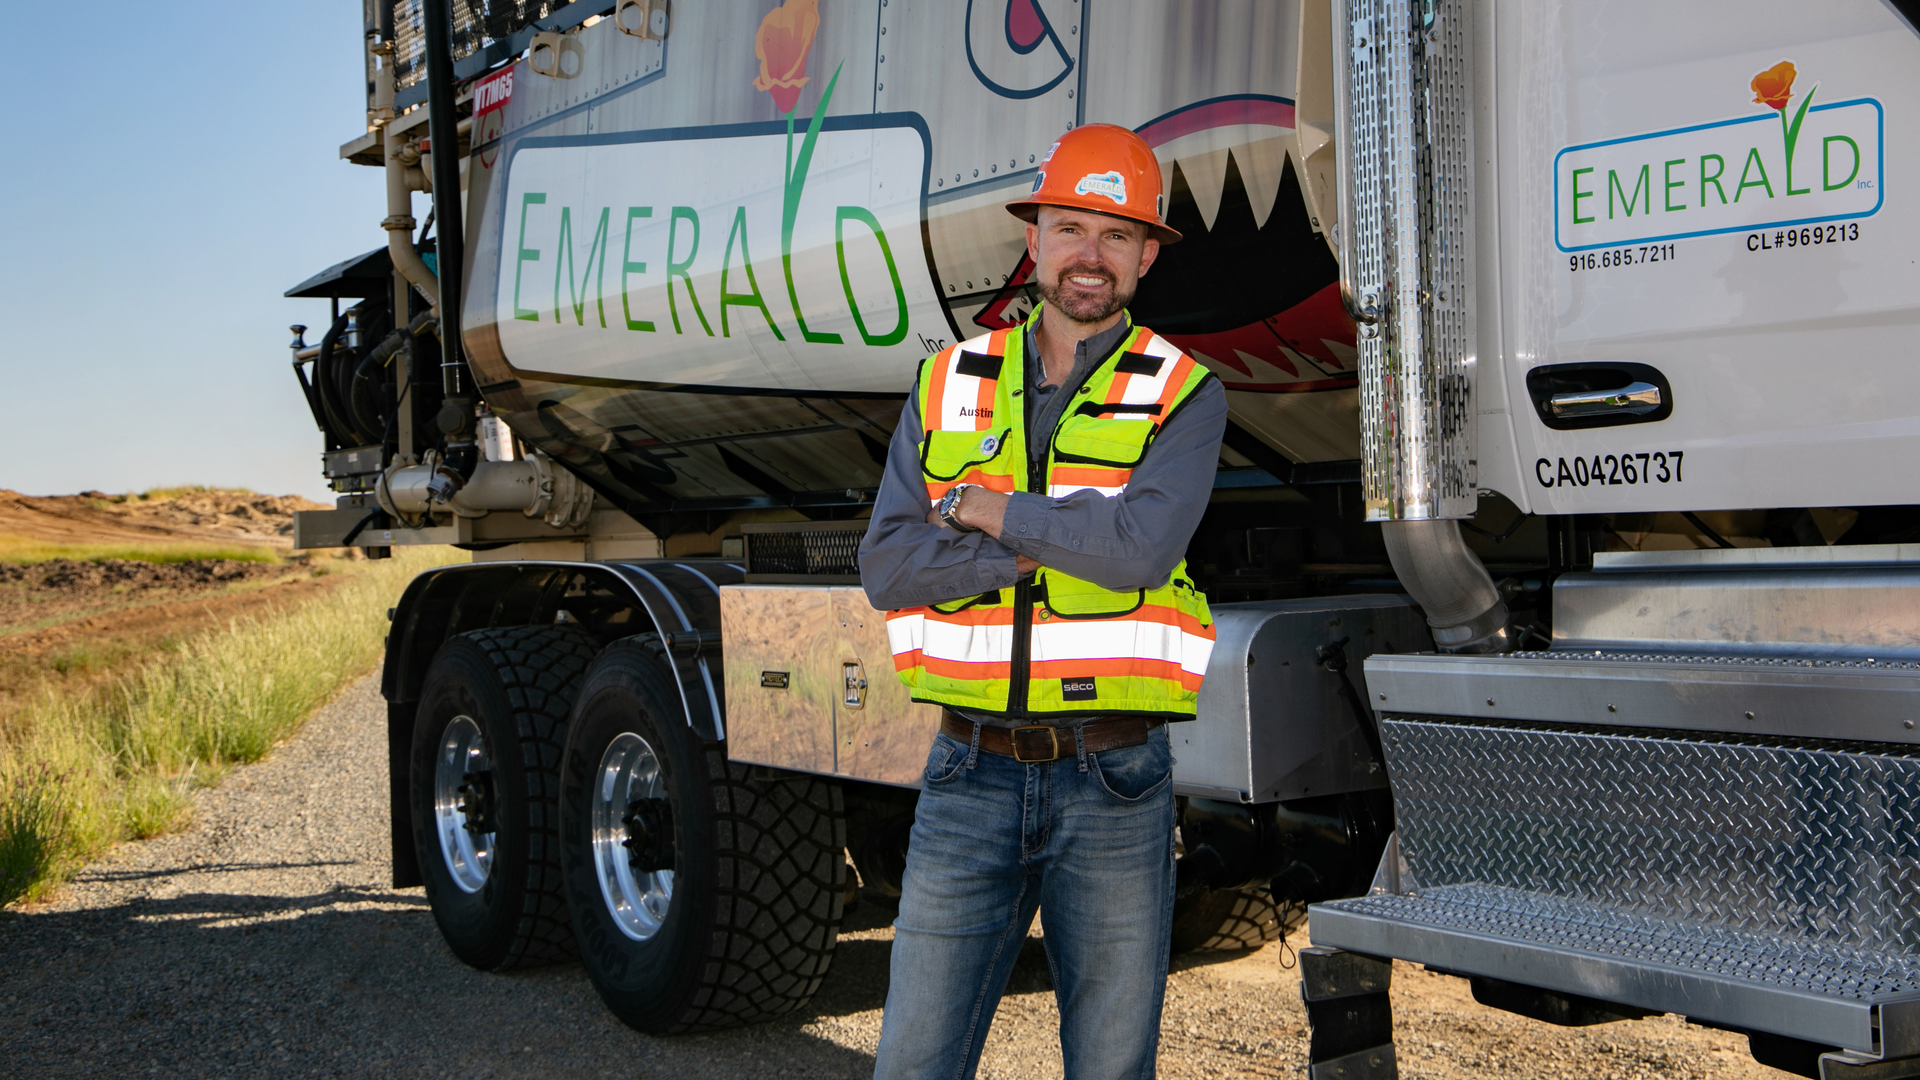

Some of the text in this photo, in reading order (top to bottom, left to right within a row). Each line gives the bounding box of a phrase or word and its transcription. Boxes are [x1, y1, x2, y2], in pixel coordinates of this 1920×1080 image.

[1082, 179, 1122, 194] EMERALD
[1572, 134, 1875, 225] EMERALD Inc.
[1746, 223, 1860, 252] CL#969213
[512, 191, 910, 347] EMERALD
[1569, 244, 1676, 272] 916.685.7211
[959, 406, 994, 418] Austin
[1535, 451, 1684, 488] CA0426737
